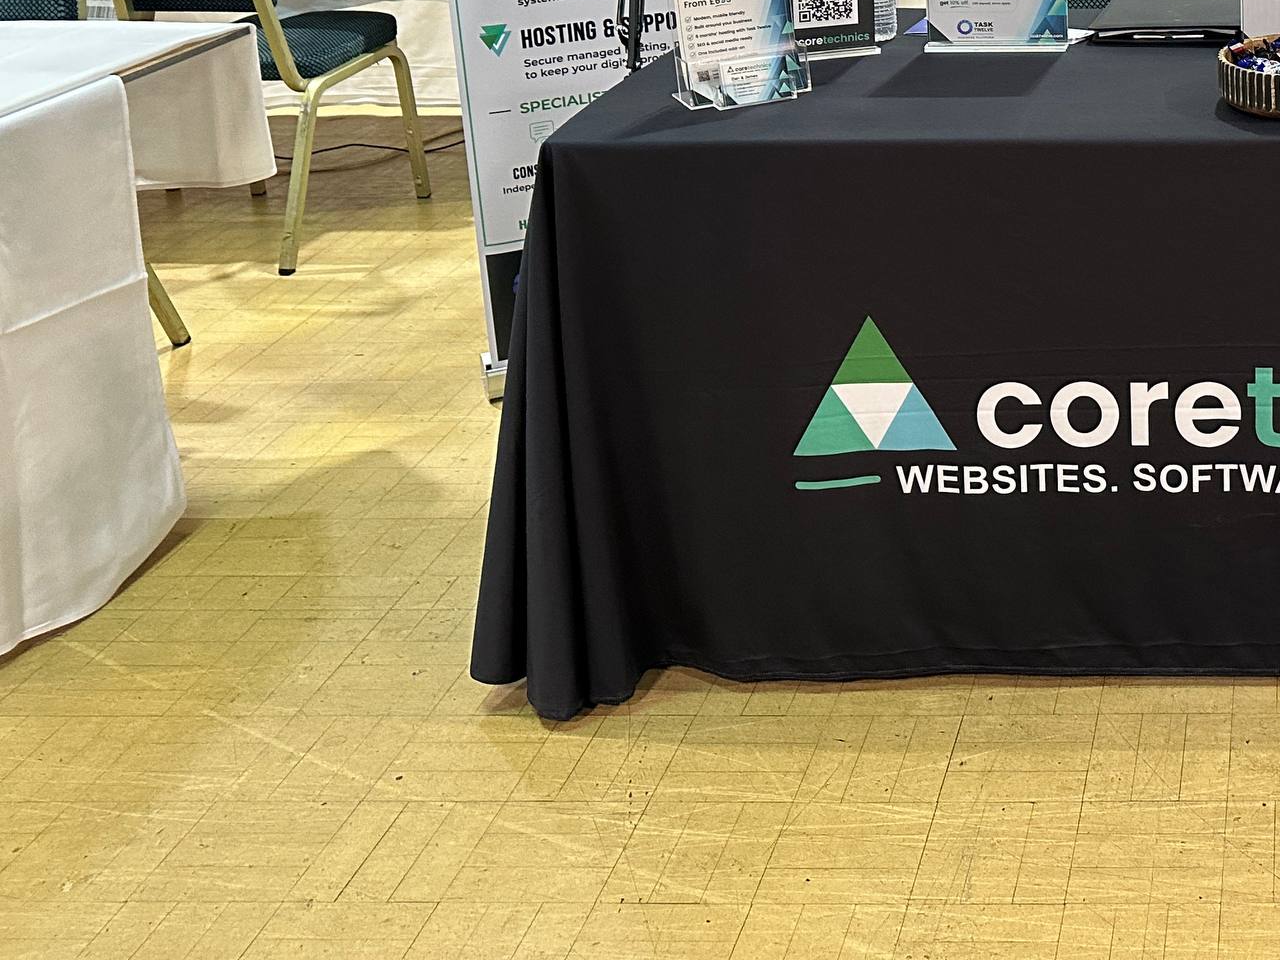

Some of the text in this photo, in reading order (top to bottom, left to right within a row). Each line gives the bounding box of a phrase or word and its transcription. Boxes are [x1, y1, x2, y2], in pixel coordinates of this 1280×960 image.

[684, 0, 707, 8] From
[521, 18, 615, 49] HOSTING &
[798, 32, 870, 47] coretechnics
[525, 62, 598, 80] to keep your
[894, 462, 1119, 496] WEBSITES.
